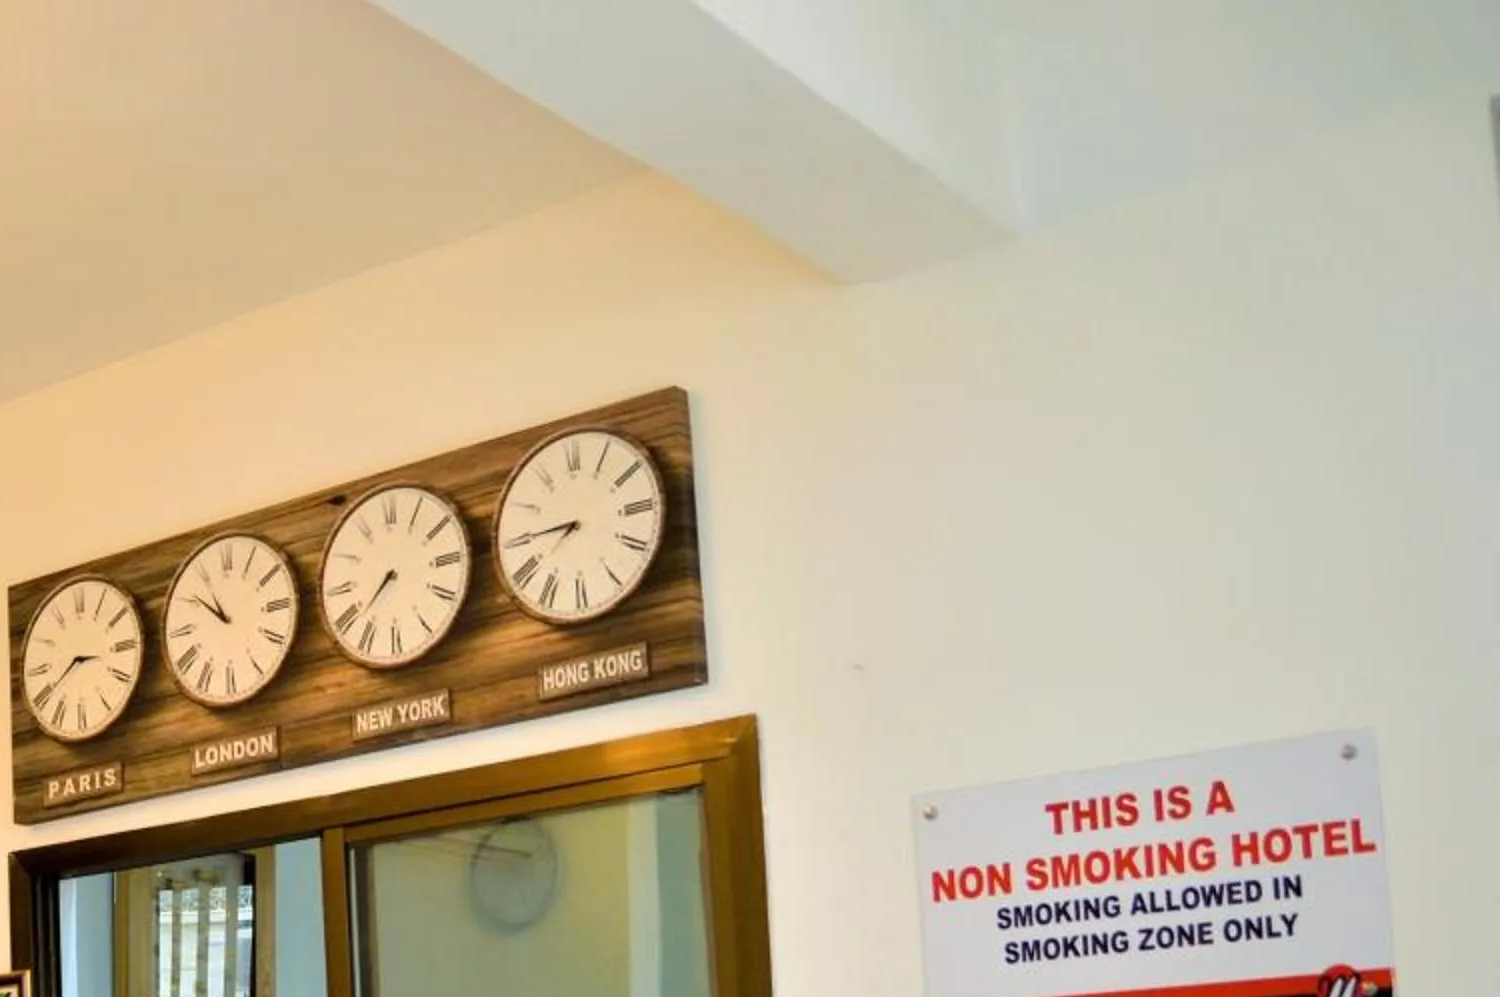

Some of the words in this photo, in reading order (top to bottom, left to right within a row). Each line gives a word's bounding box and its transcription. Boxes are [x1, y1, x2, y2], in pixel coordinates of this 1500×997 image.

[543, 663, 589, 690] HONG
[594, 651, 642, 680] KONG
[356, 708, 394, 733] NEW
[397, 697, 445, 725] YORK
[195, 734, 274, 769] LONDON
[48, 768, 117, 799] PARIS
[1045, 792, 1139, 835] THIS
[1154, 785, 1192, 822] IS
[1206, 780, 1235, 815] A
[931, 862, 1013, 902] NON
[1026, 837, 1216, 892] SMOKING
[1231, 819, 1376, 868] HOTEL
[997, 895, 1121, 930] SMOKING
[1130, 879, 1264, 916] ALLOWED
[1273, 875, 1303, 899] IN
[1004, 930, 1130, 964] SMOKING
[1138, 922, 1214, 950] ZONE
[1223, 913, 1299, 943] ONLY
